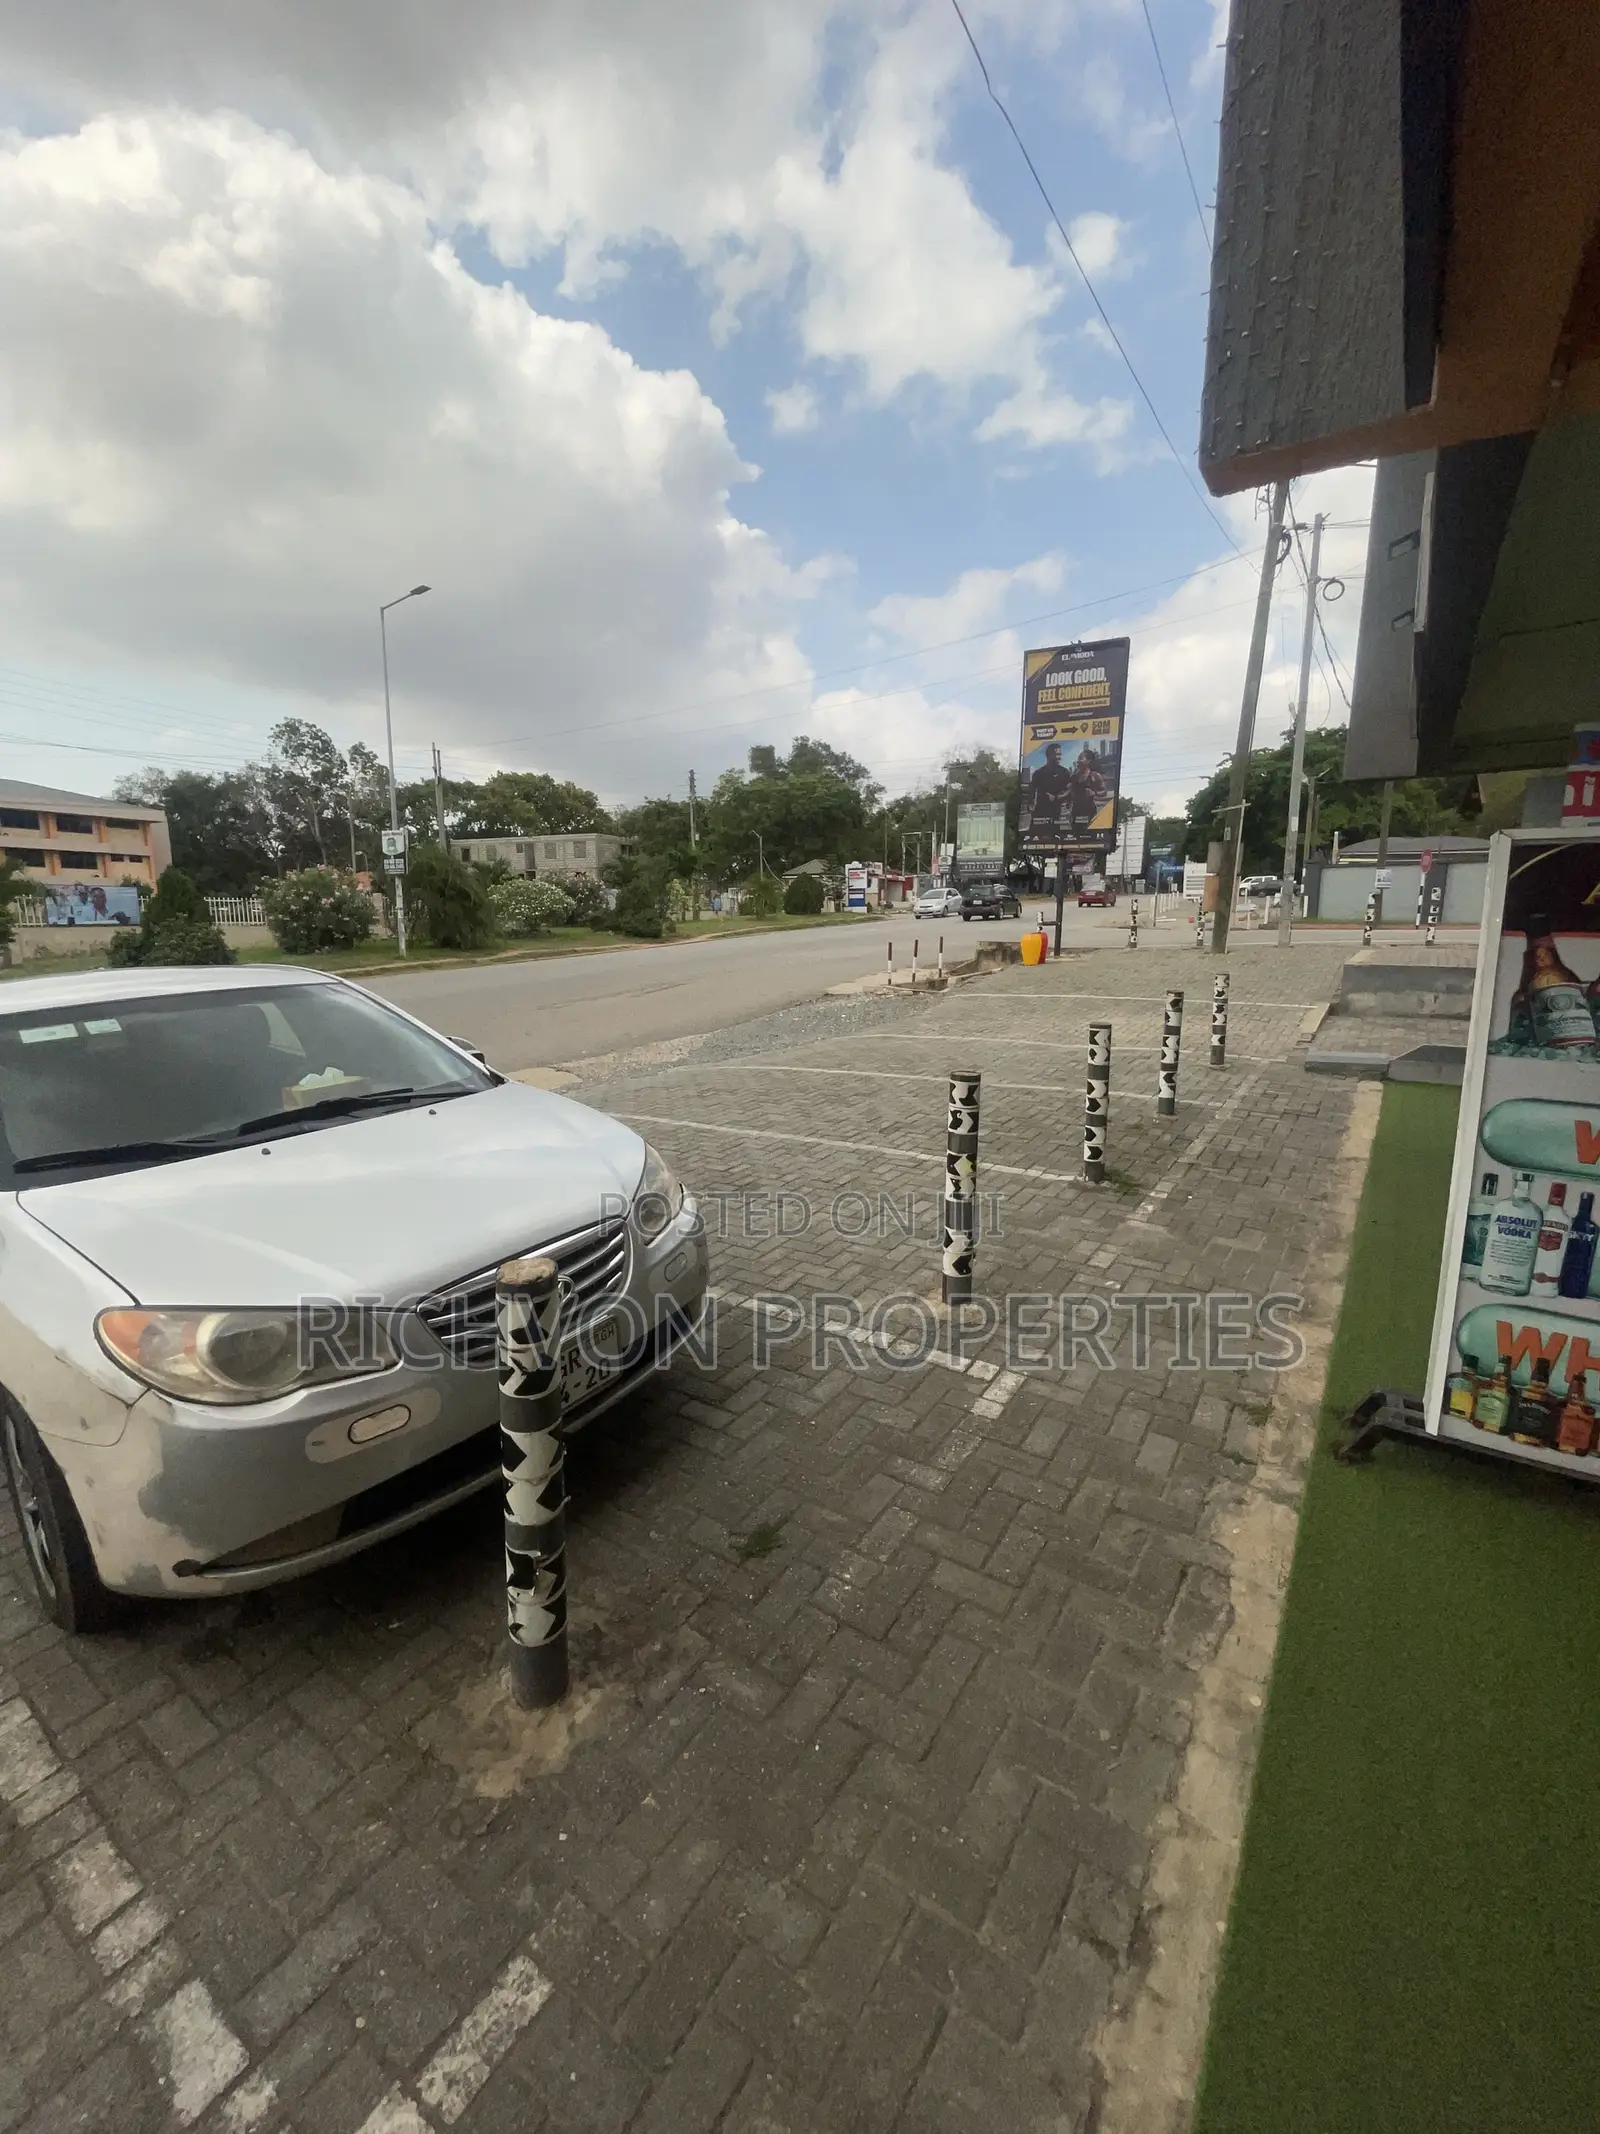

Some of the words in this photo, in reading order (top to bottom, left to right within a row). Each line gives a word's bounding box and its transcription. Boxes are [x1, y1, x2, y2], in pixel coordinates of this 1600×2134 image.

[1045, 670, 1073, 687] LOOK
[1075, 667, 1106, 683] GOOD,
[1038, 688, 1056, 702] FEEL
[1058, 682, 1111, 700] CONFIDENT.
[1494, 1214, 1538, 1229] ABSOLUT
[1496, 1226, 1532, 1240] VODKA
